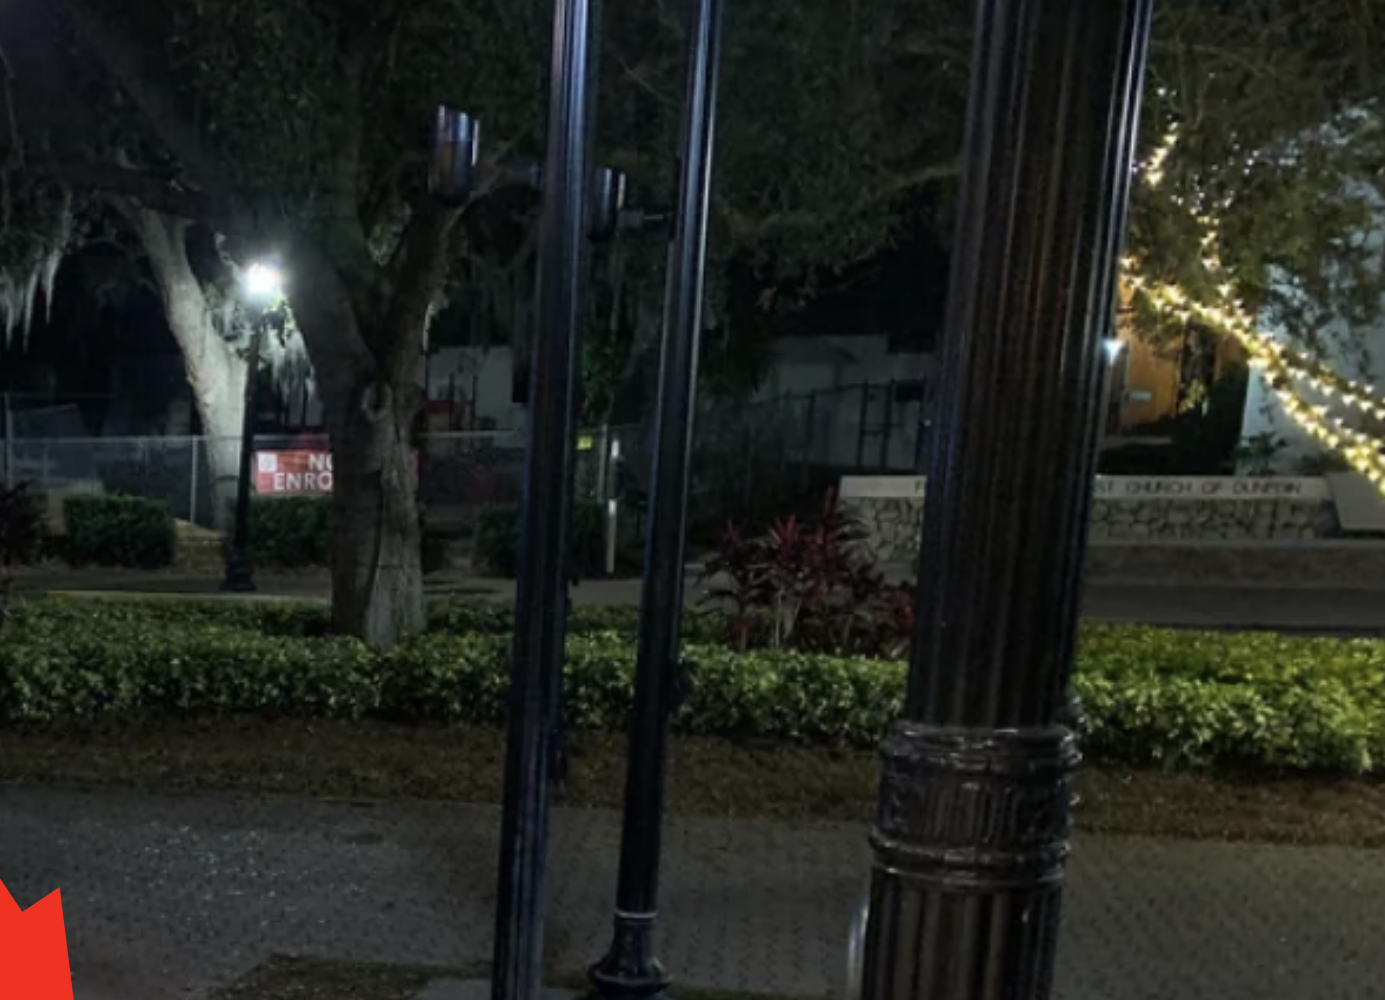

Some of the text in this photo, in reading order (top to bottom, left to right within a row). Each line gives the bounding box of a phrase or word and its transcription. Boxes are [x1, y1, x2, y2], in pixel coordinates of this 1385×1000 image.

[274, 472, 333, 491] ENRO
[1125, 481, 1193, 495] CHURCH
[1201, 481, 1223, 495] OF
